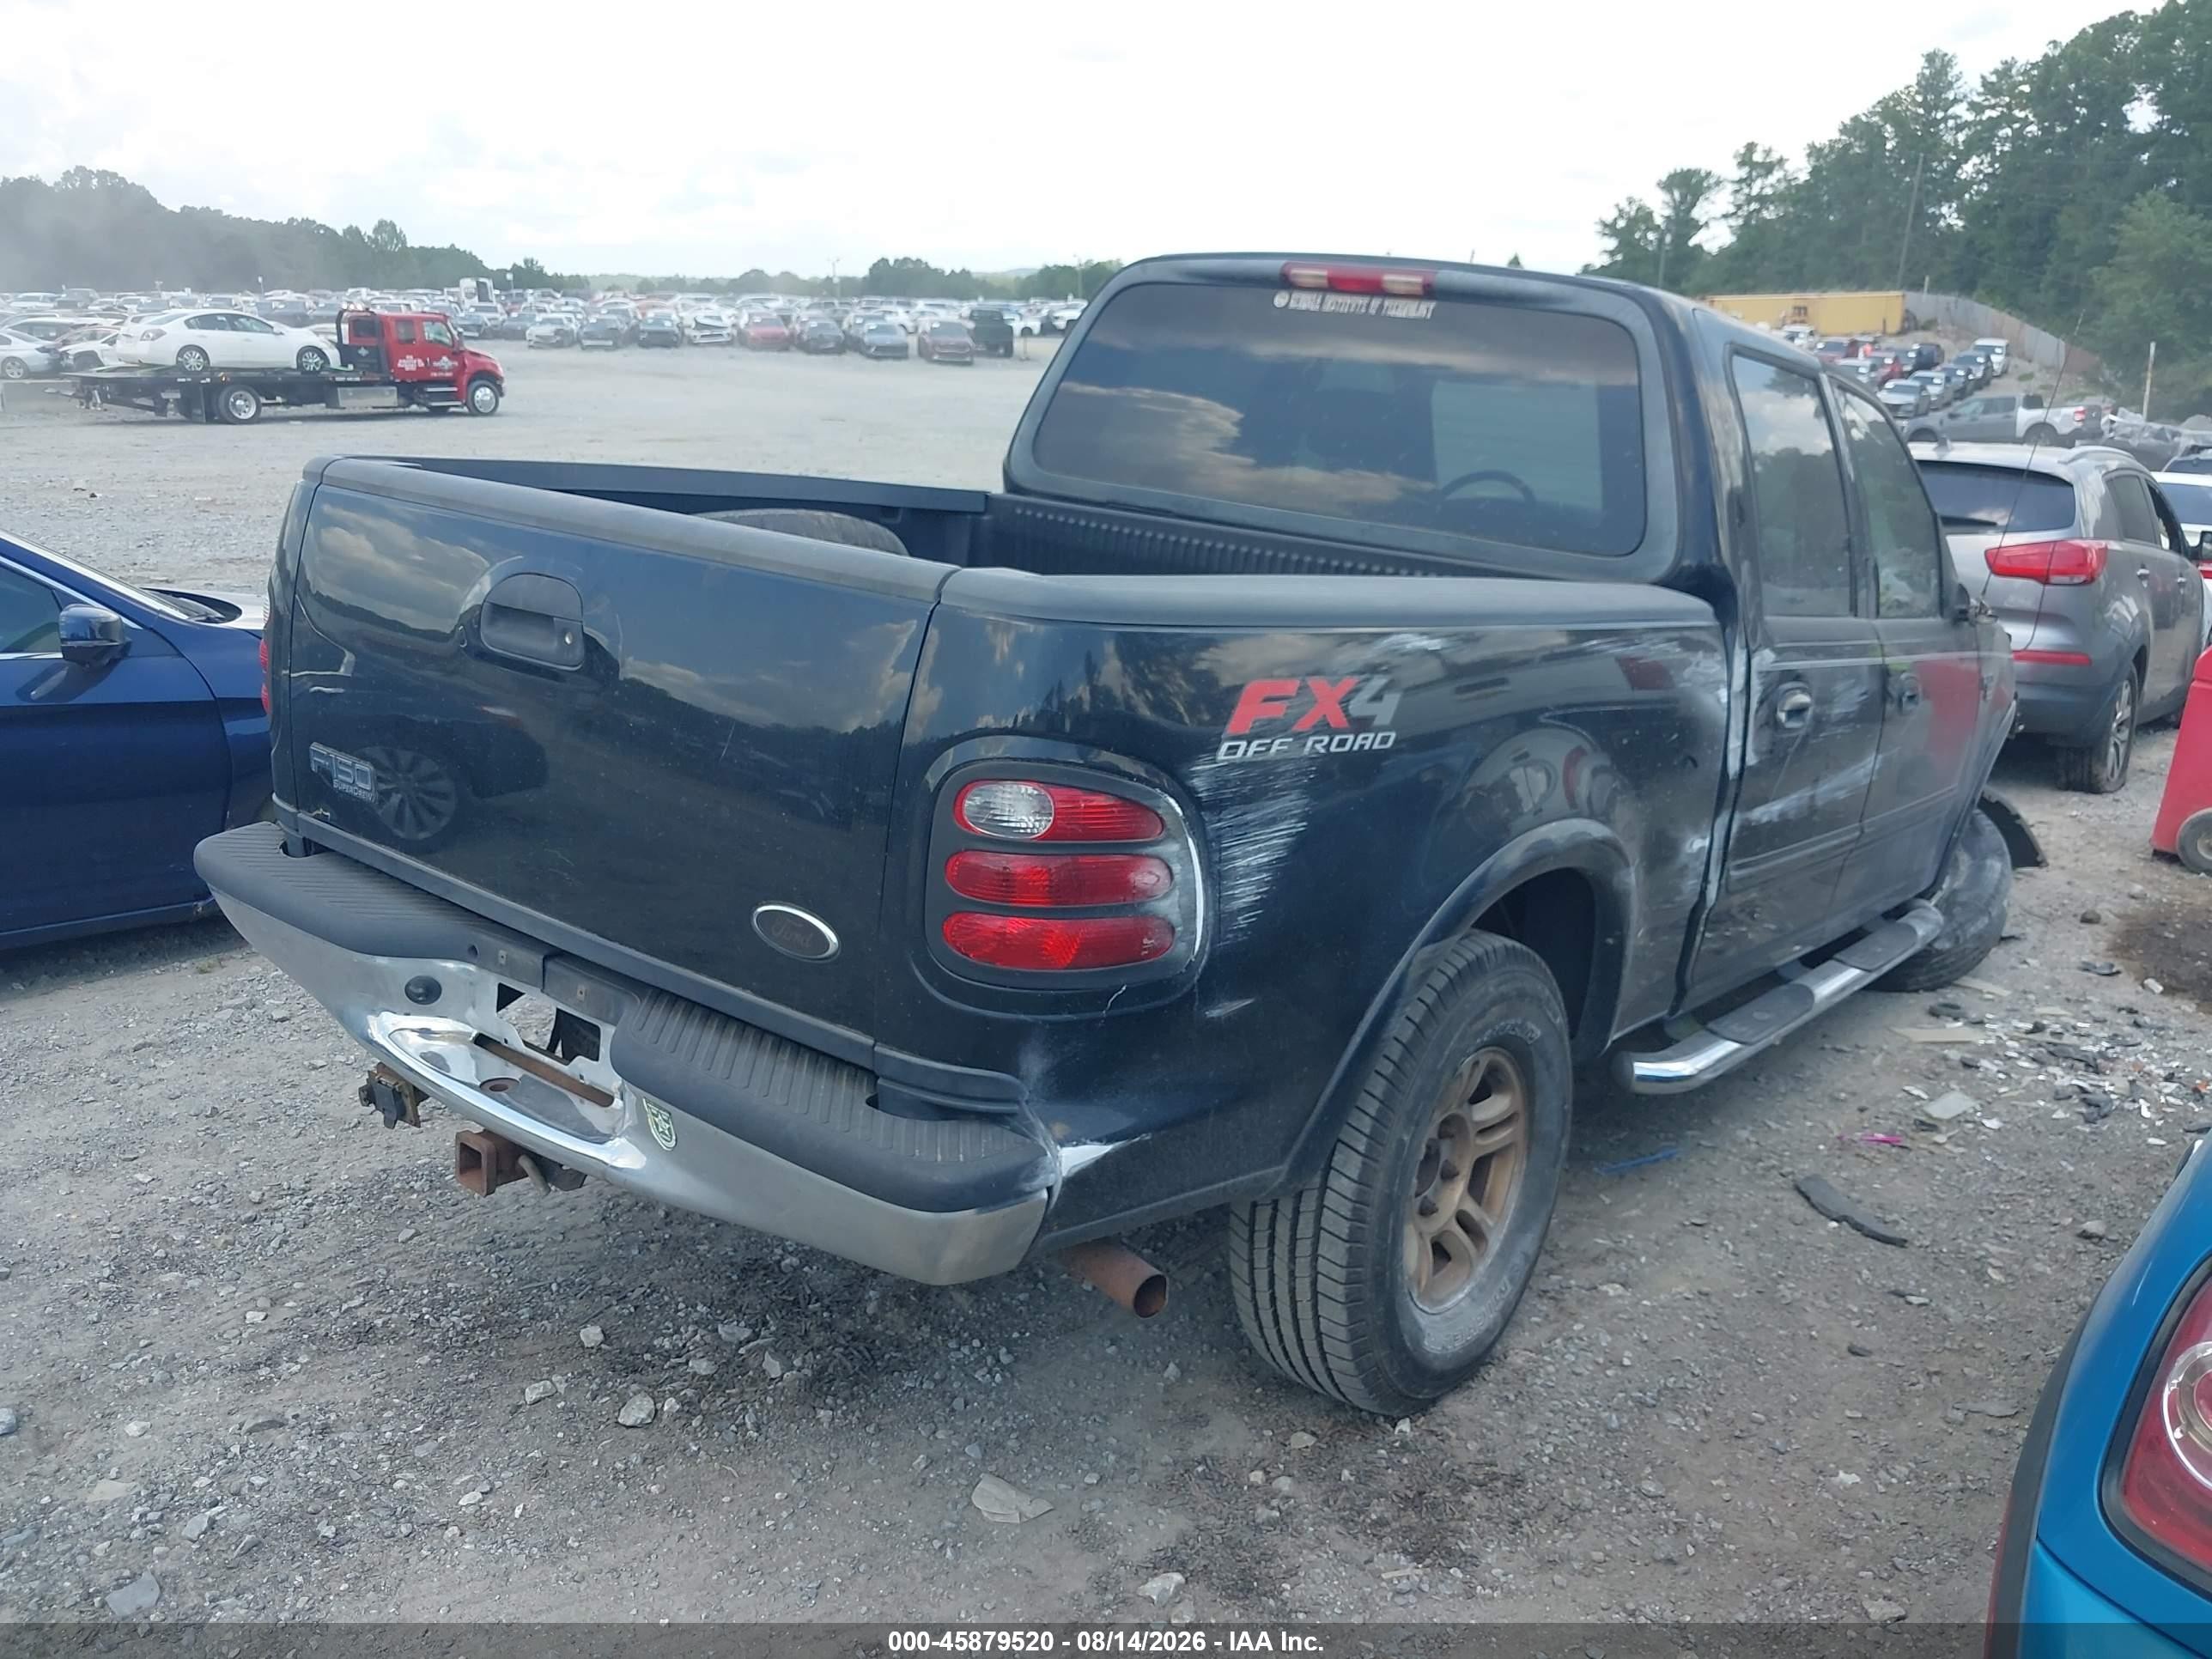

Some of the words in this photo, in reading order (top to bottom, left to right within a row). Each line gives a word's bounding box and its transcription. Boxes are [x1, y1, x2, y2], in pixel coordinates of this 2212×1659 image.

[1322, 294, 1370, 314] TITUTE
[1382, 299, 1436, 319] TECLY
[1225, 674, 1402, 735] FX4
[1217, 737, 1293, 761] OFF
[1304, 732, 1396, 755] ROAD
